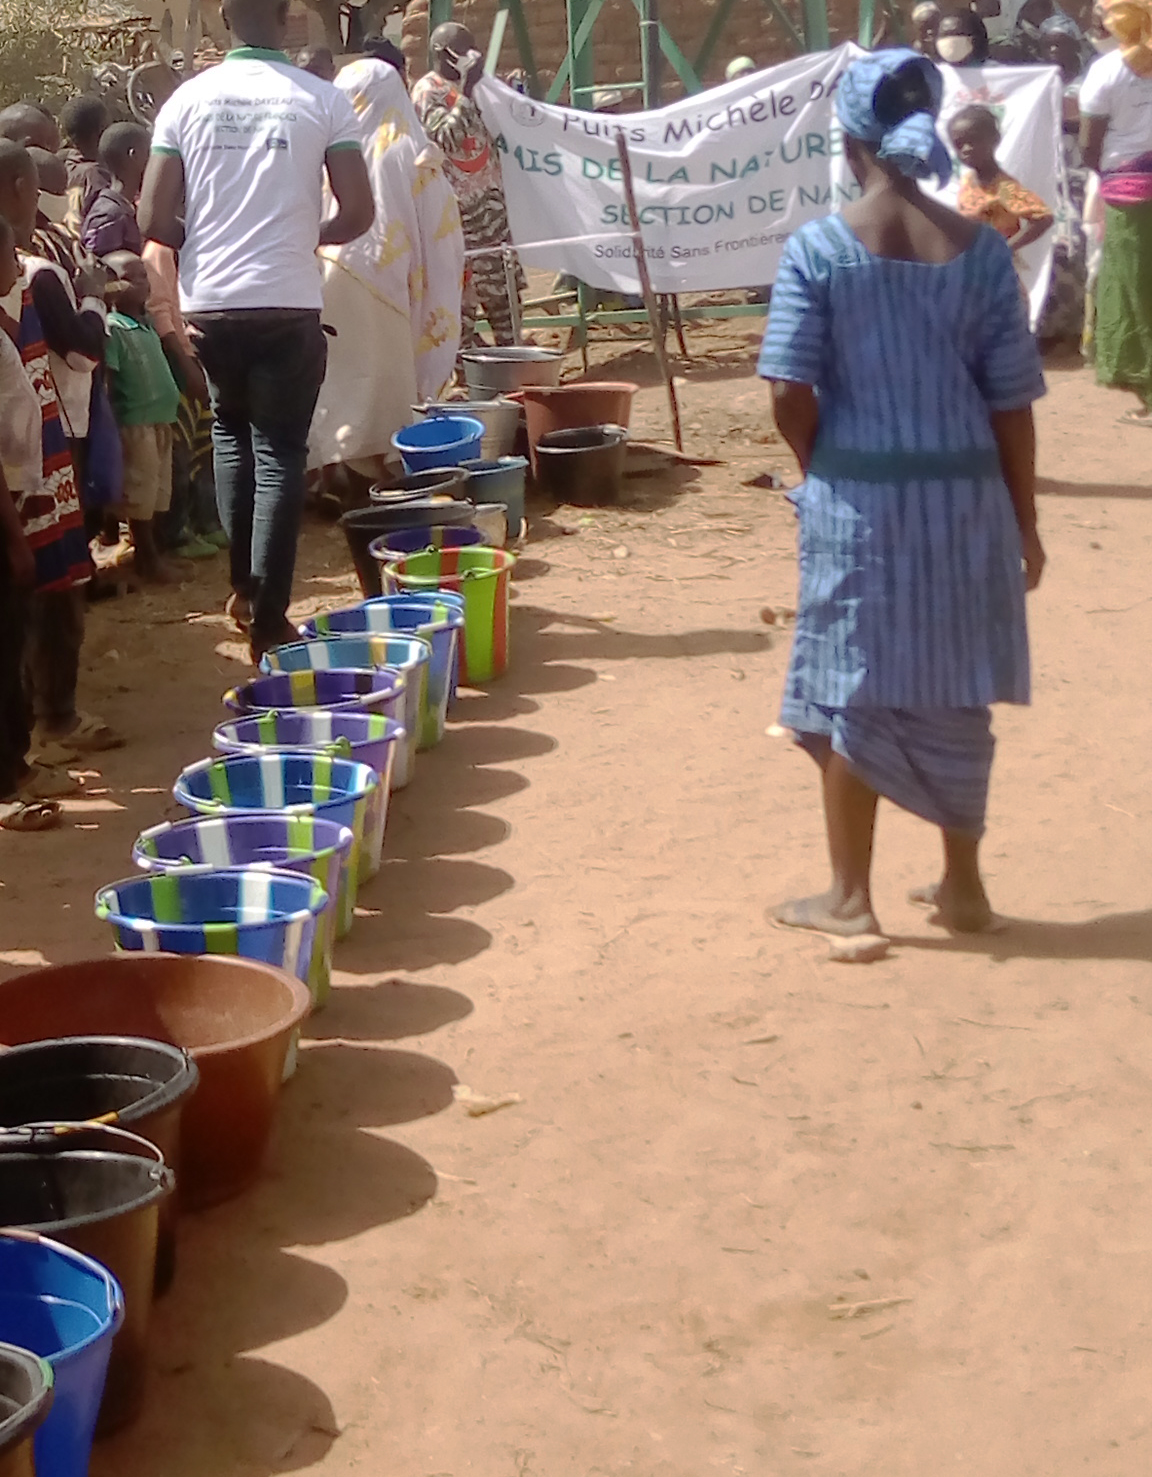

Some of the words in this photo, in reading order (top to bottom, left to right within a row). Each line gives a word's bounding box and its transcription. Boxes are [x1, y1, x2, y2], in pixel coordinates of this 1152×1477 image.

[562, 114, 646, 142] Puits
[664, 89, 797, 143] Michèle
[582, 157, 624, 182] DE
[647, 161, 690, 184] LA
[748, 189, 785, 214] DE
[670, 244, 710, 259] Sans
